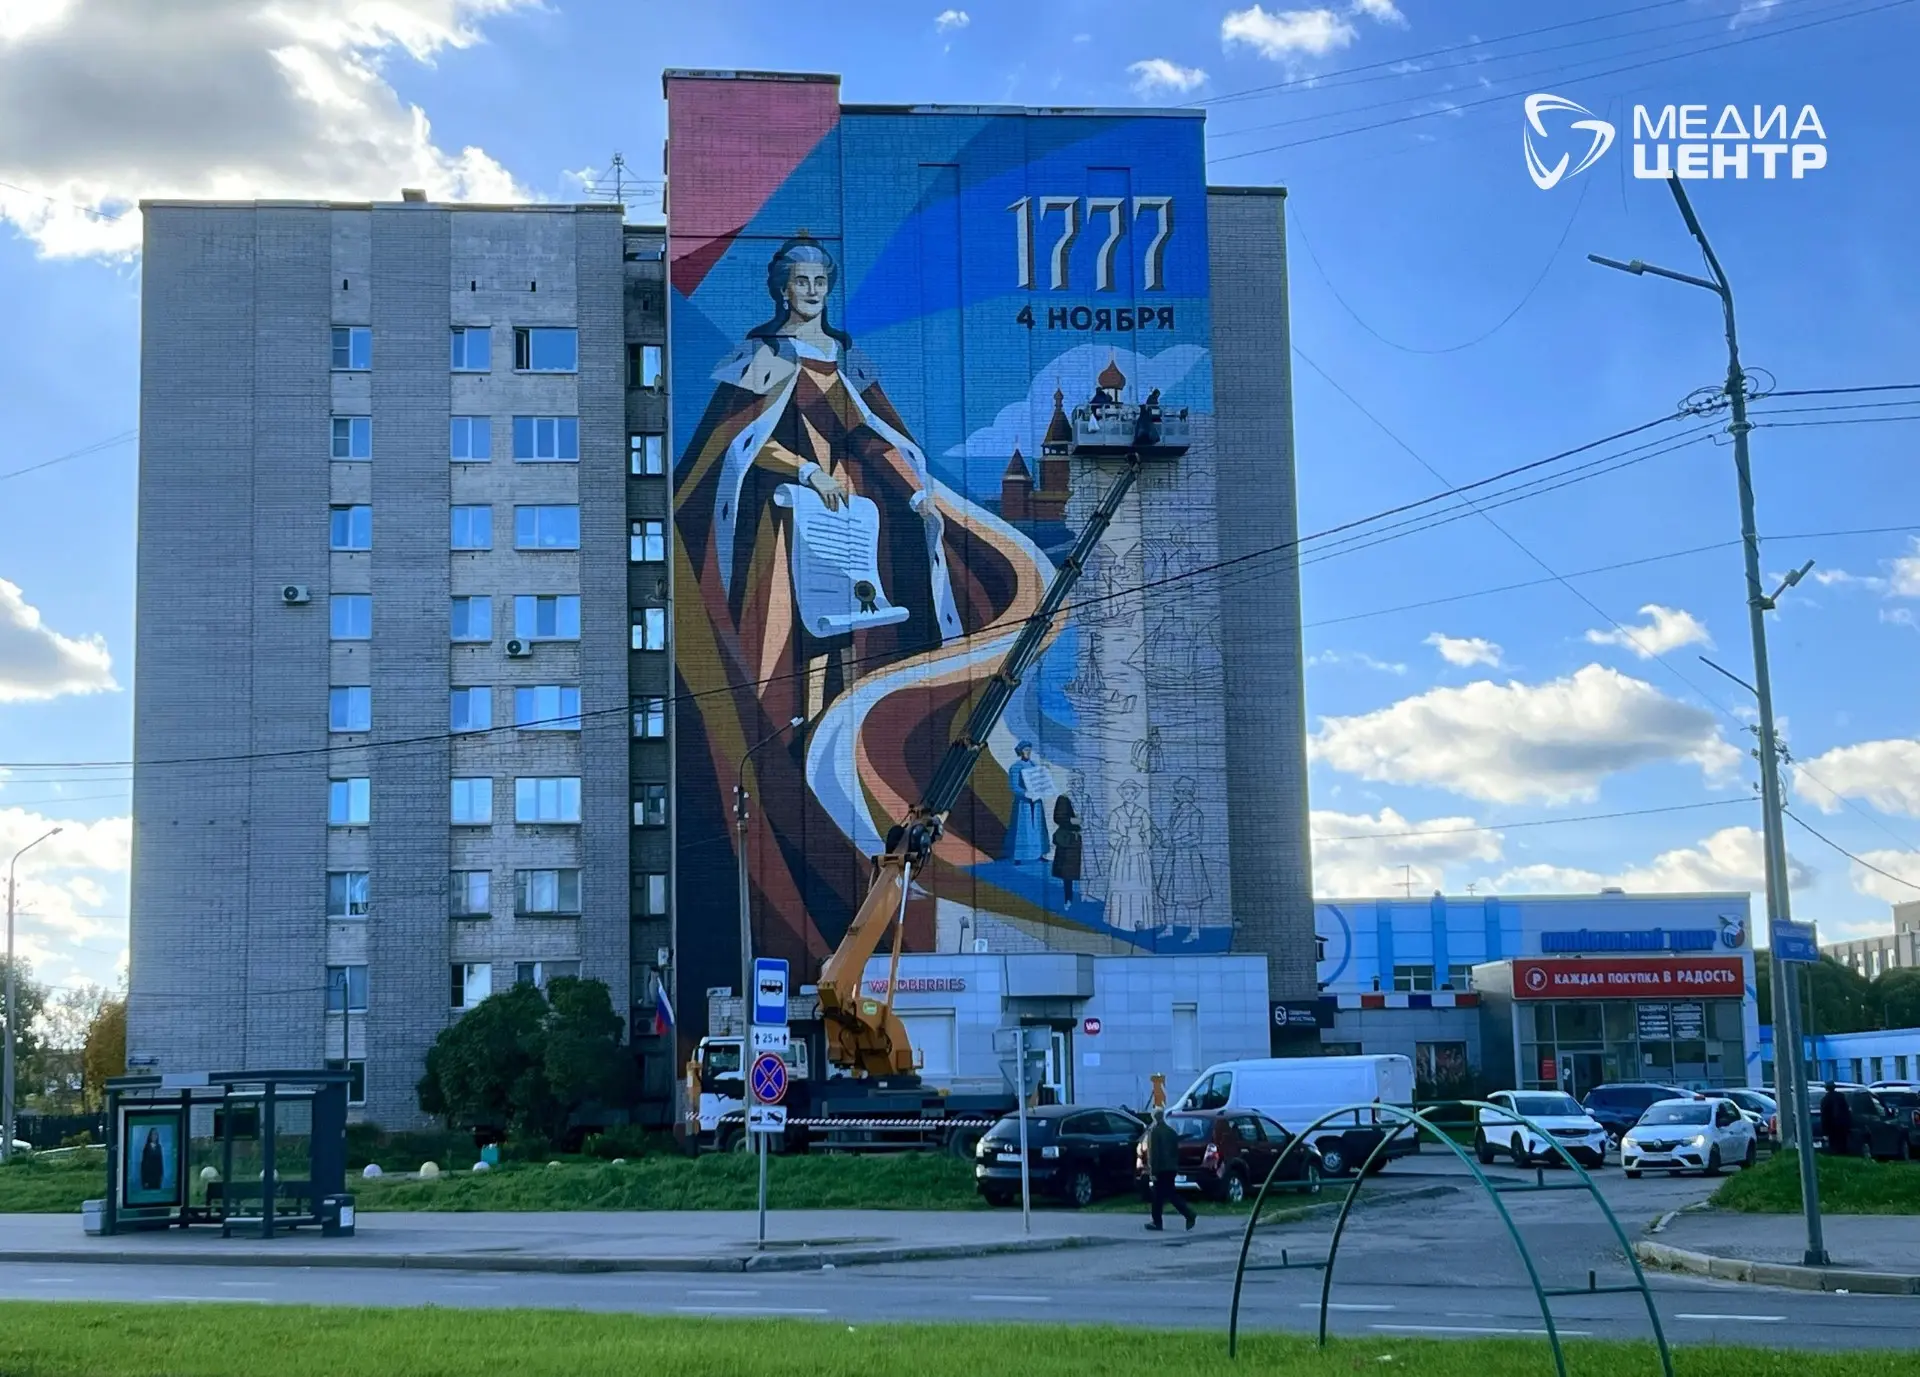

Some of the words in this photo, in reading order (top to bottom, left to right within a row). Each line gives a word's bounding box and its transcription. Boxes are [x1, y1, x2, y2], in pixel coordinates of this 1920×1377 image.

[1006, 196, 1174, 292] 1777
[1016, 306, 1036, 330] 4
[1048, 306, 1175, 332] НОЯБРЯ
[869, 978, 967, 993] WIDBERRIES
[1554, 973, 1604, 985] КАЖДАЯ
[1608, 972, 1660, 984] ПОКУПКА
[1663, 971, 1671, 983] В
[1677, 970, 1736, 984] РАДОСТЬ
